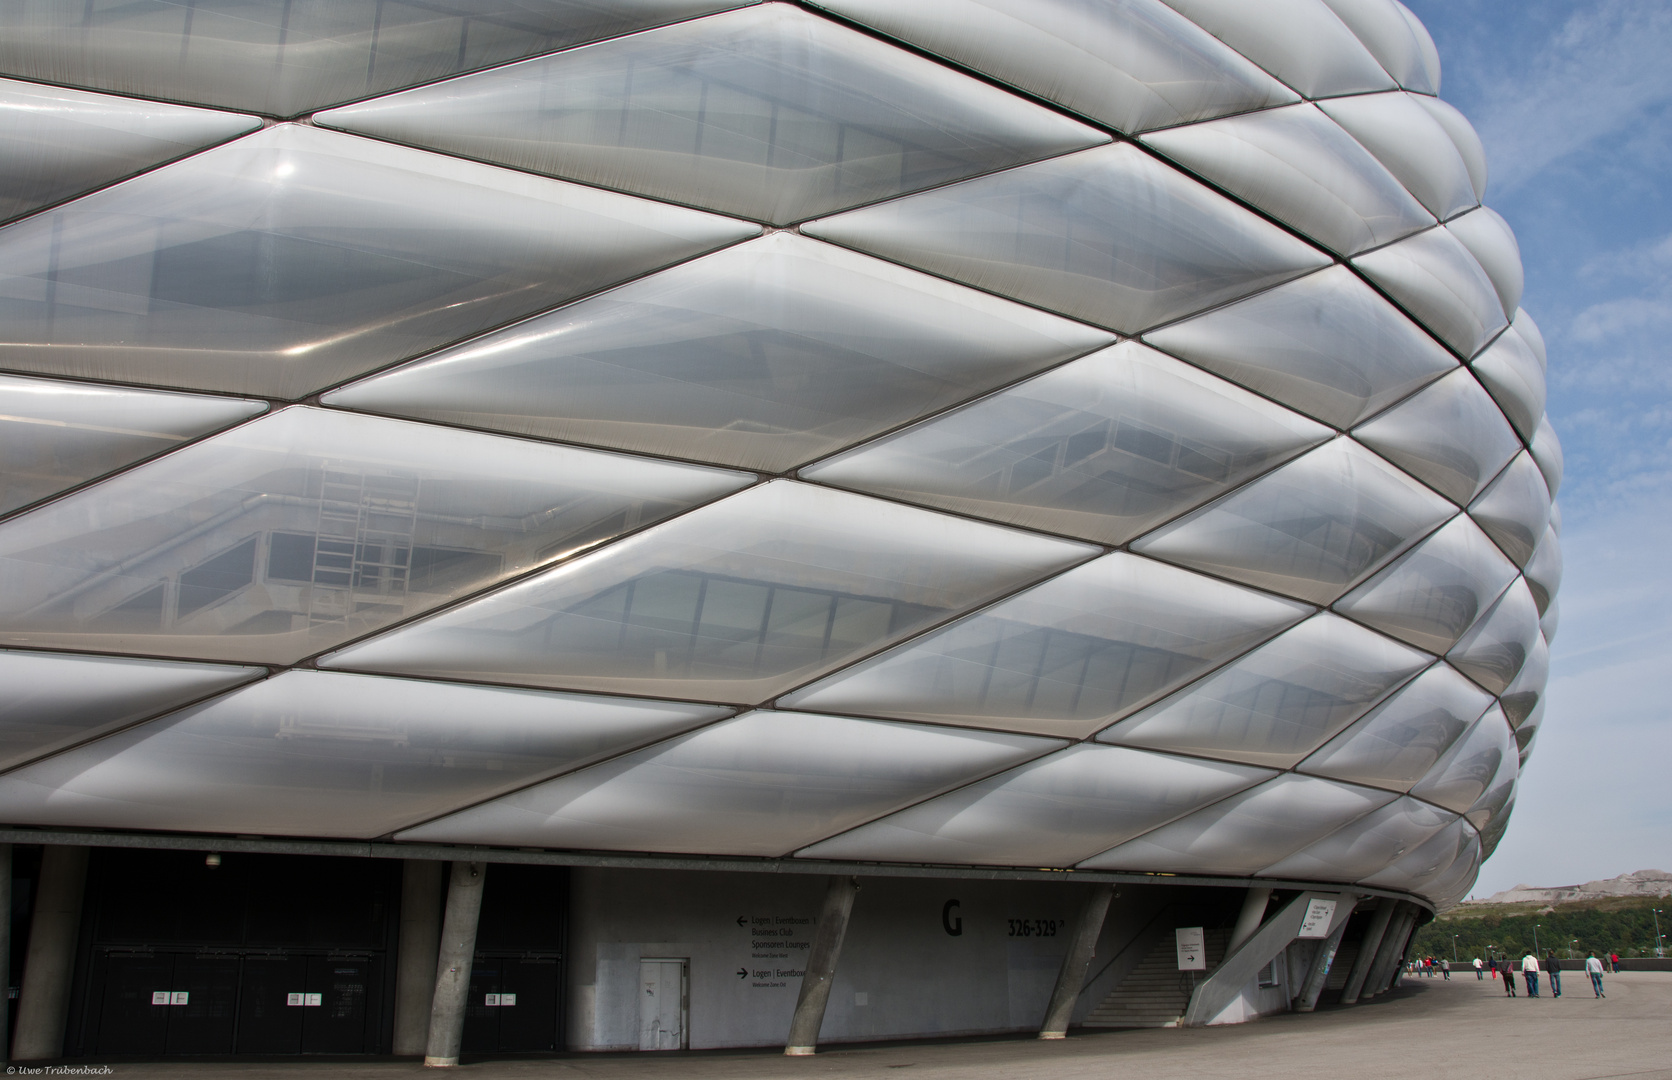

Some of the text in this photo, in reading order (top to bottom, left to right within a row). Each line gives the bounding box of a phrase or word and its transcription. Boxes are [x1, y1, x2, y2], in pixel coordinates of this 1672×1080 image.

[752, 916, 771, 926] Logen
[776, 916, 809, 925] Eventboxen
[942, 898, 963, 937] G
[752, 928, 794, 936] Business Club
[1007, 919, 1057, 937] 326-329
[752, 940, 810, 950] Sponsoren Lounges
[752, 969, 772, 979] Logen
